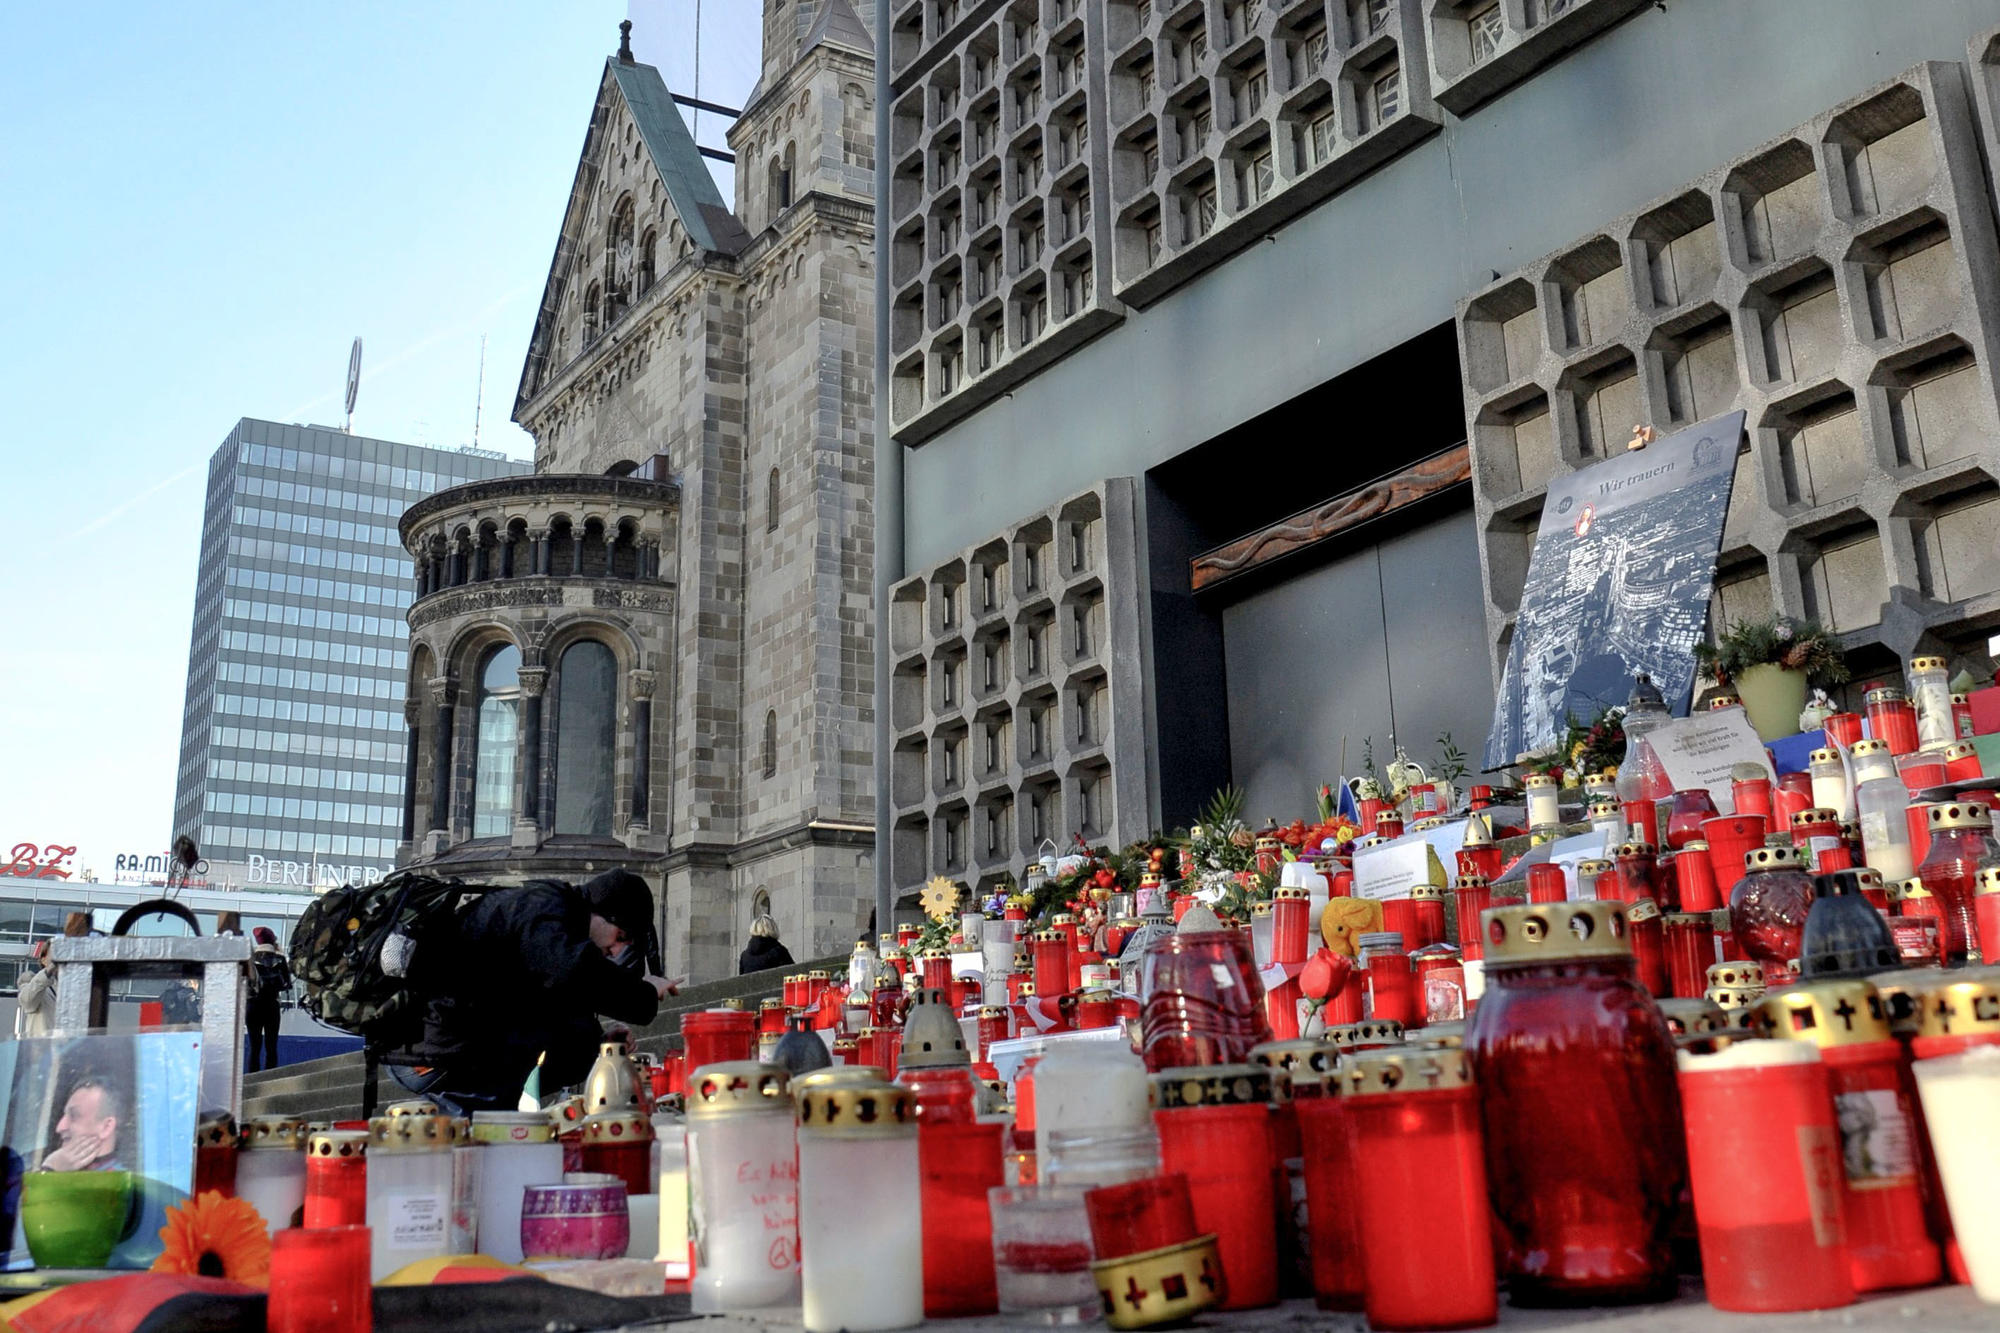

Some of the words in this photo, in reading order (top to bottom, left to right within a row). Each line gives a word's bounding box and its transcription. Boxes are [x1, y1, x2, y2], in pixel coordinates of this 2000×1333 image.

[1599, 480, 1625, 496] Wir
[1627, 462, 1675, 486] trauern
[247, 853, 381, 888] BERLINER
